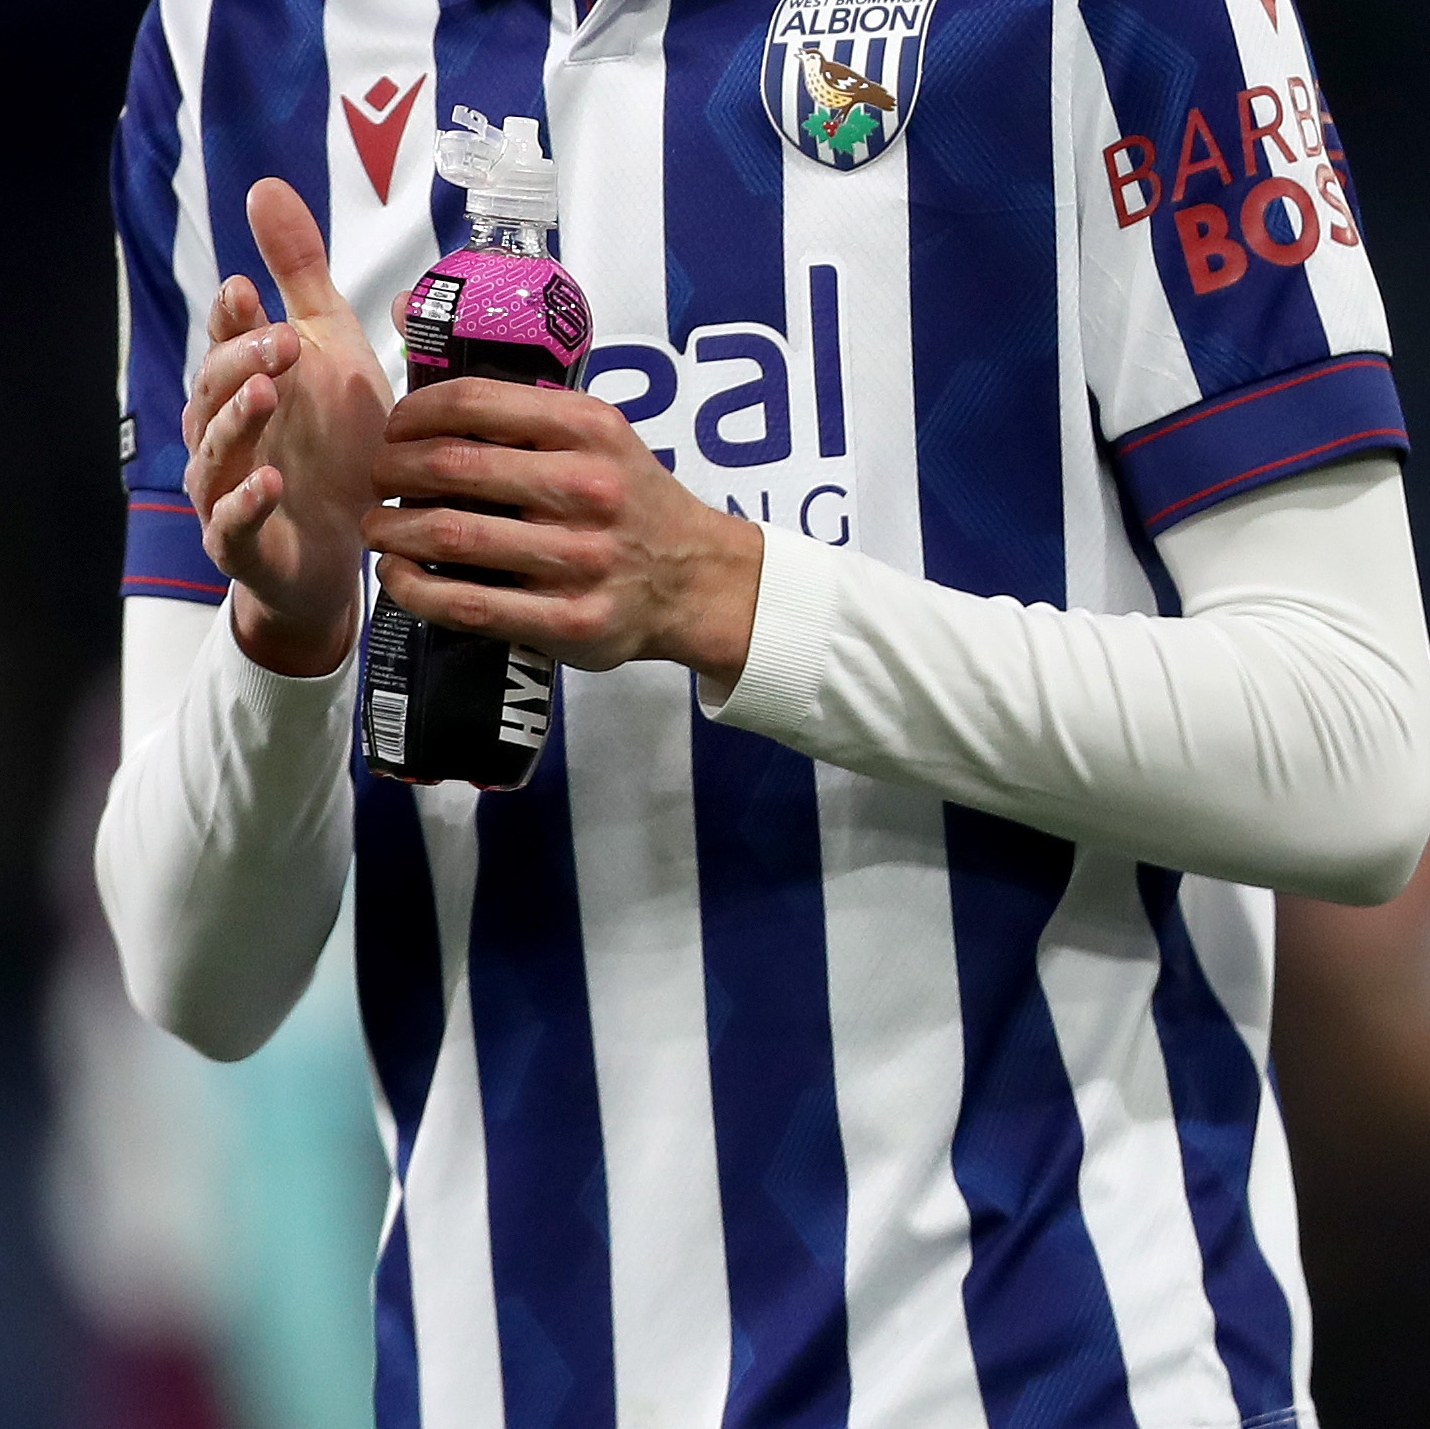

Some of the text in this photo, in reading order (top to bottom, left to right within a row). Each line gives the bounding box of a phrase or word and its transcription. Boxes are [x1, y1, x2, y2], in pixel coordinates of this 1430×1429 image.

[780, 6, 920, 36] ALBION
[1173, 163, 1359, 295] BOS
[575, 263, 847, 473] eal
